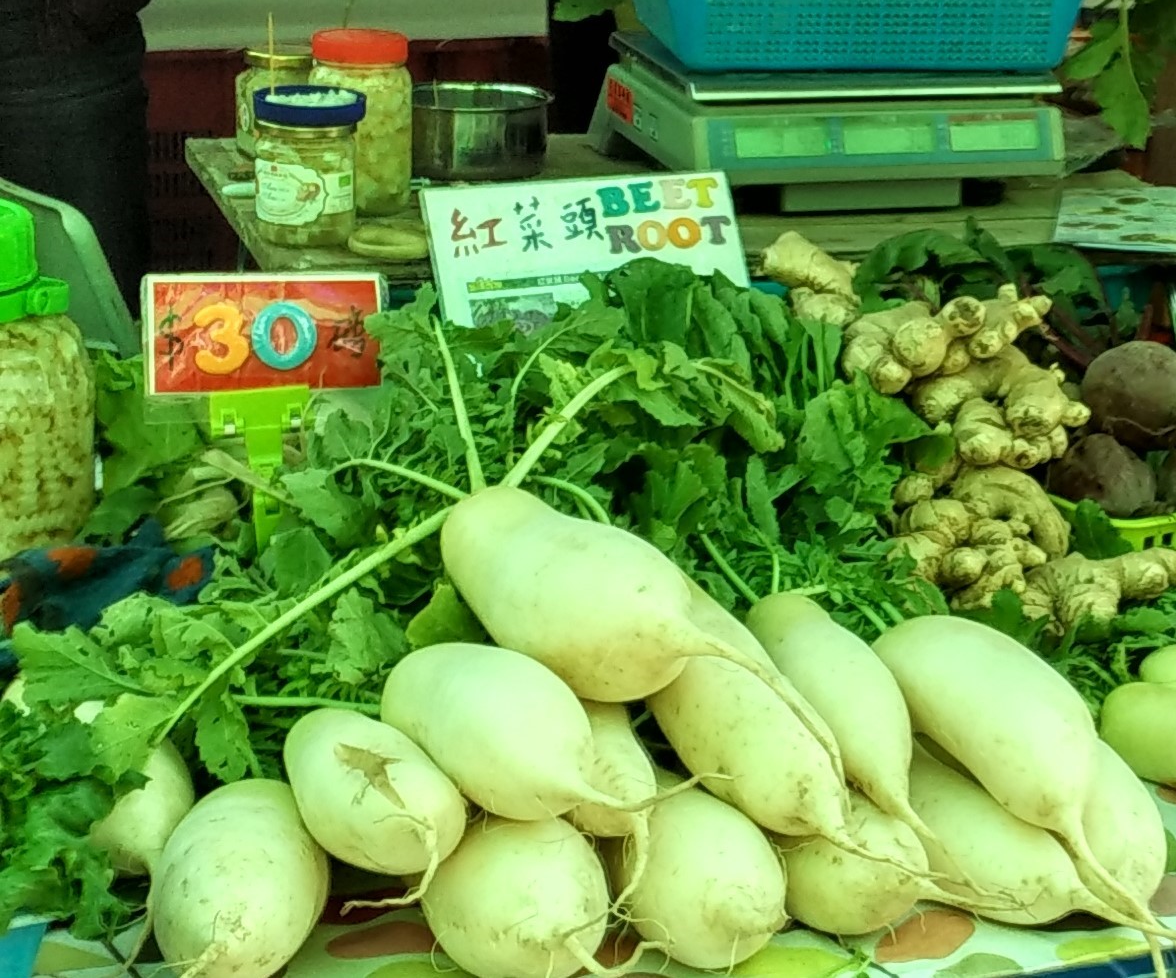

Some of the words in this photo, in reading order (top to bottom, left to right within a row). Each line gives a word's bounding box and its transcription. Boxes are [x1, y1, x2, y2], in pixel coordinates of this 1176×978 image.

[596, 177, 717, 219] BEET
[450, 196, 604, 259] 紅菜頭
[605, 215, 731, 254] ROOT
